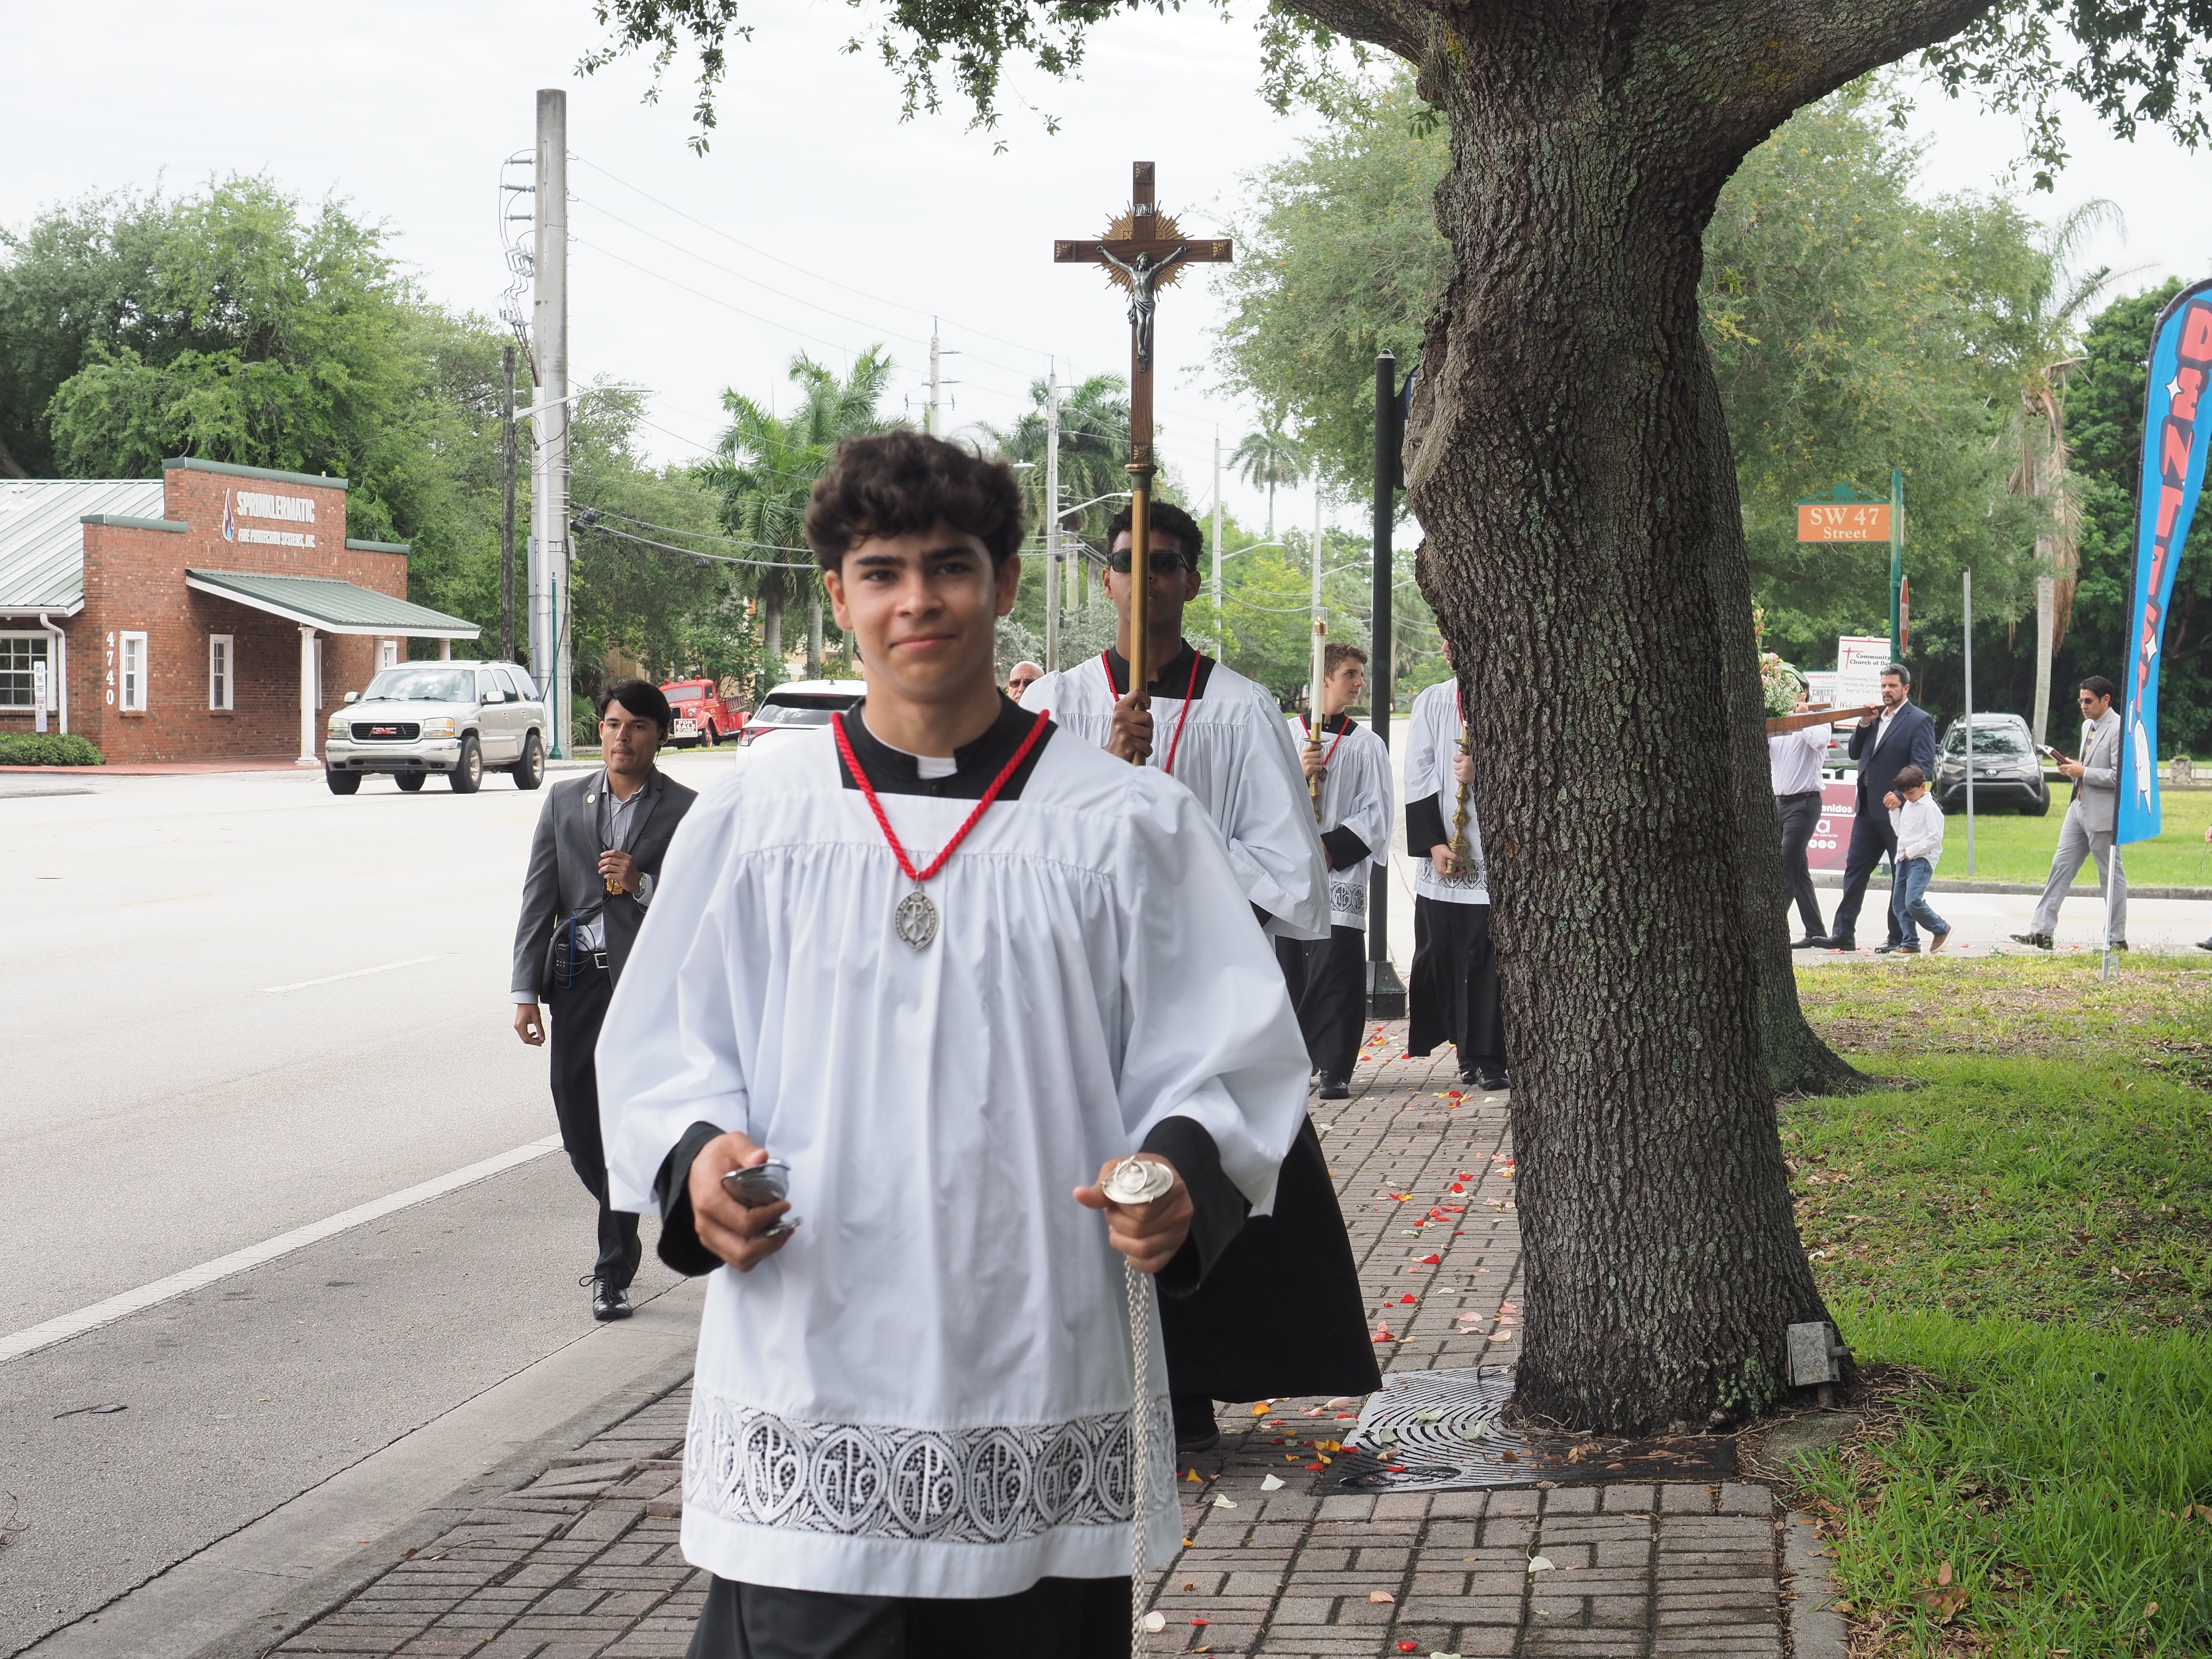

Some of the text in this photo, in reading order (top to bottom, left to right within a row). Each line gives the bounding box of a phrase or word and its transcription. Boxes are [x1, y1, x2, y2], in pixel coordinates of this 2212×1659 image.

[236, 491, 315, 523] SPRINKLERMATIC
[1810, 507, 1879, 526] SW 47
[238, 528, 315, 549] FIRE PROTECTION SYSTEMS, INC.
[1823, 527, 1868, 539] Street
[106, 631, 114, 705] 4740
[1822, 804, 1852, 813] enidos
